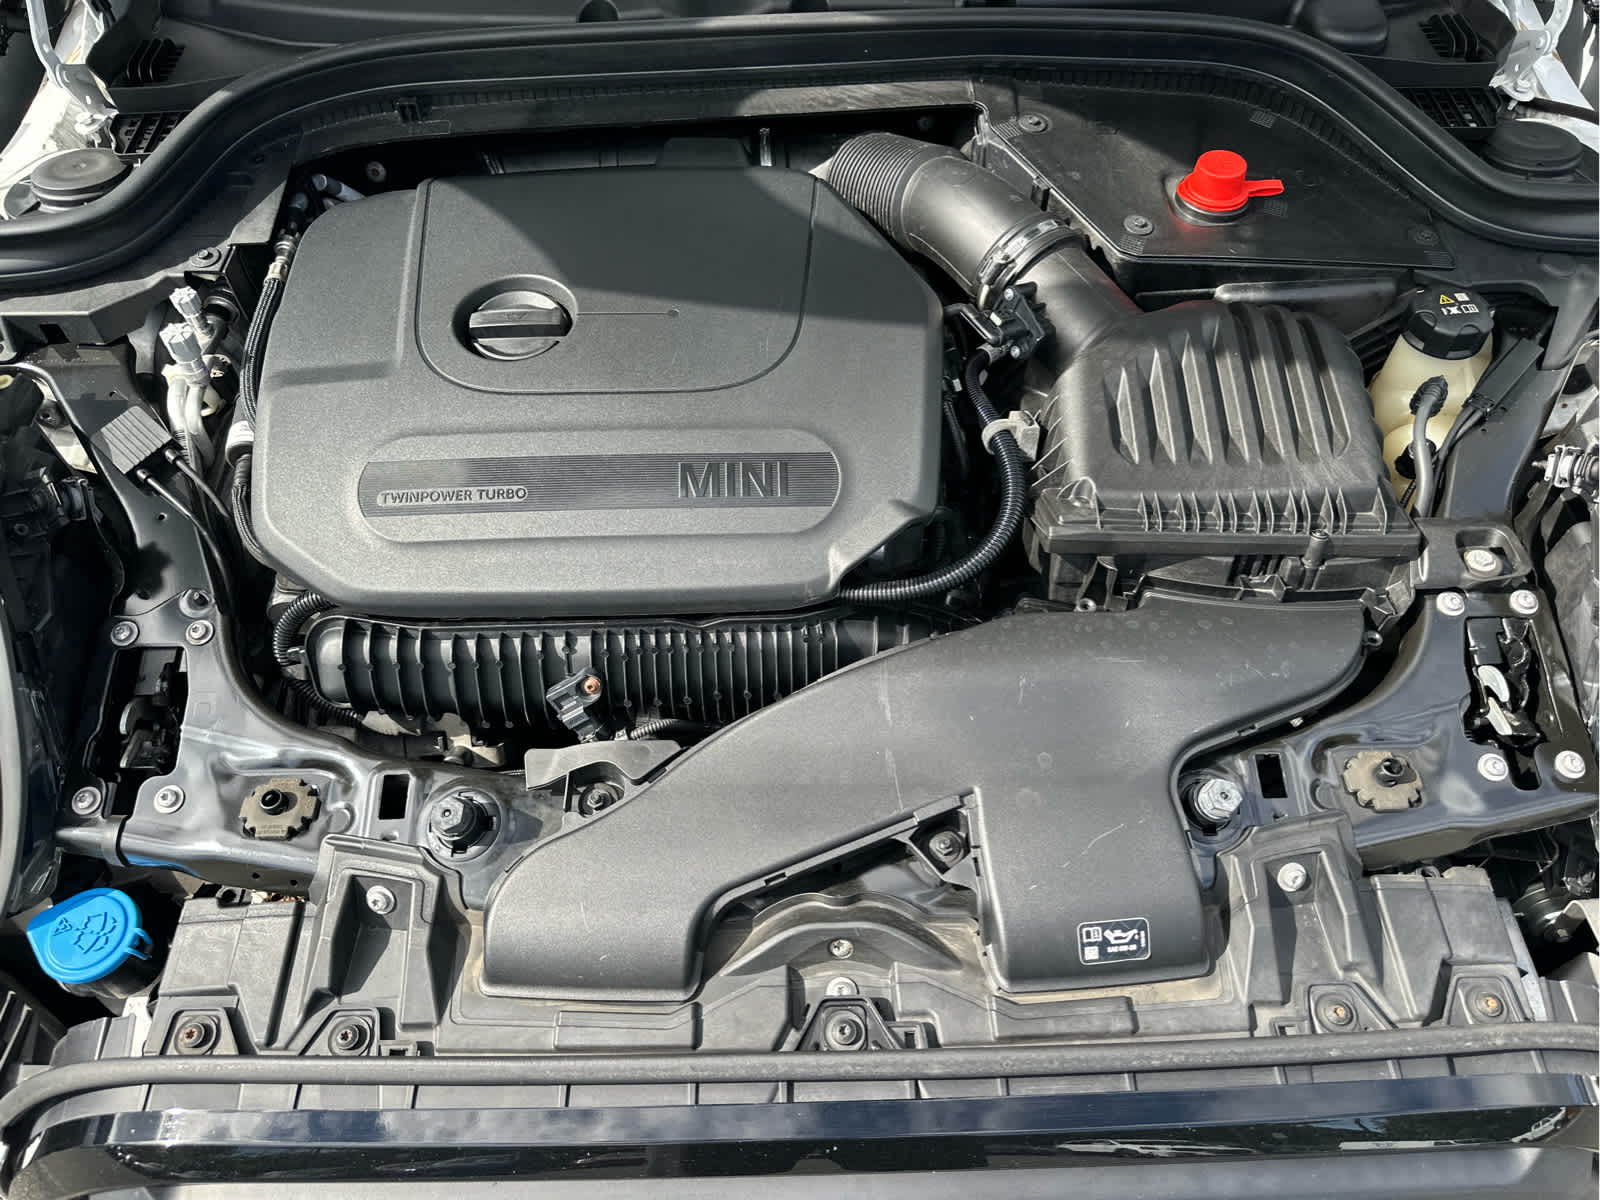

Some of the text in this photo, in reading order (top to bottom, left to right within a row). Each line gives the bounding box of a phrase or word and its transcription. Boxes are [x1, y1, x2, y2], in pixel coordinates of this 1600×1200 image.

[678, 461, 789, 498] MINI
[381, 487, 527, 504] TWINPOWER TURBO
